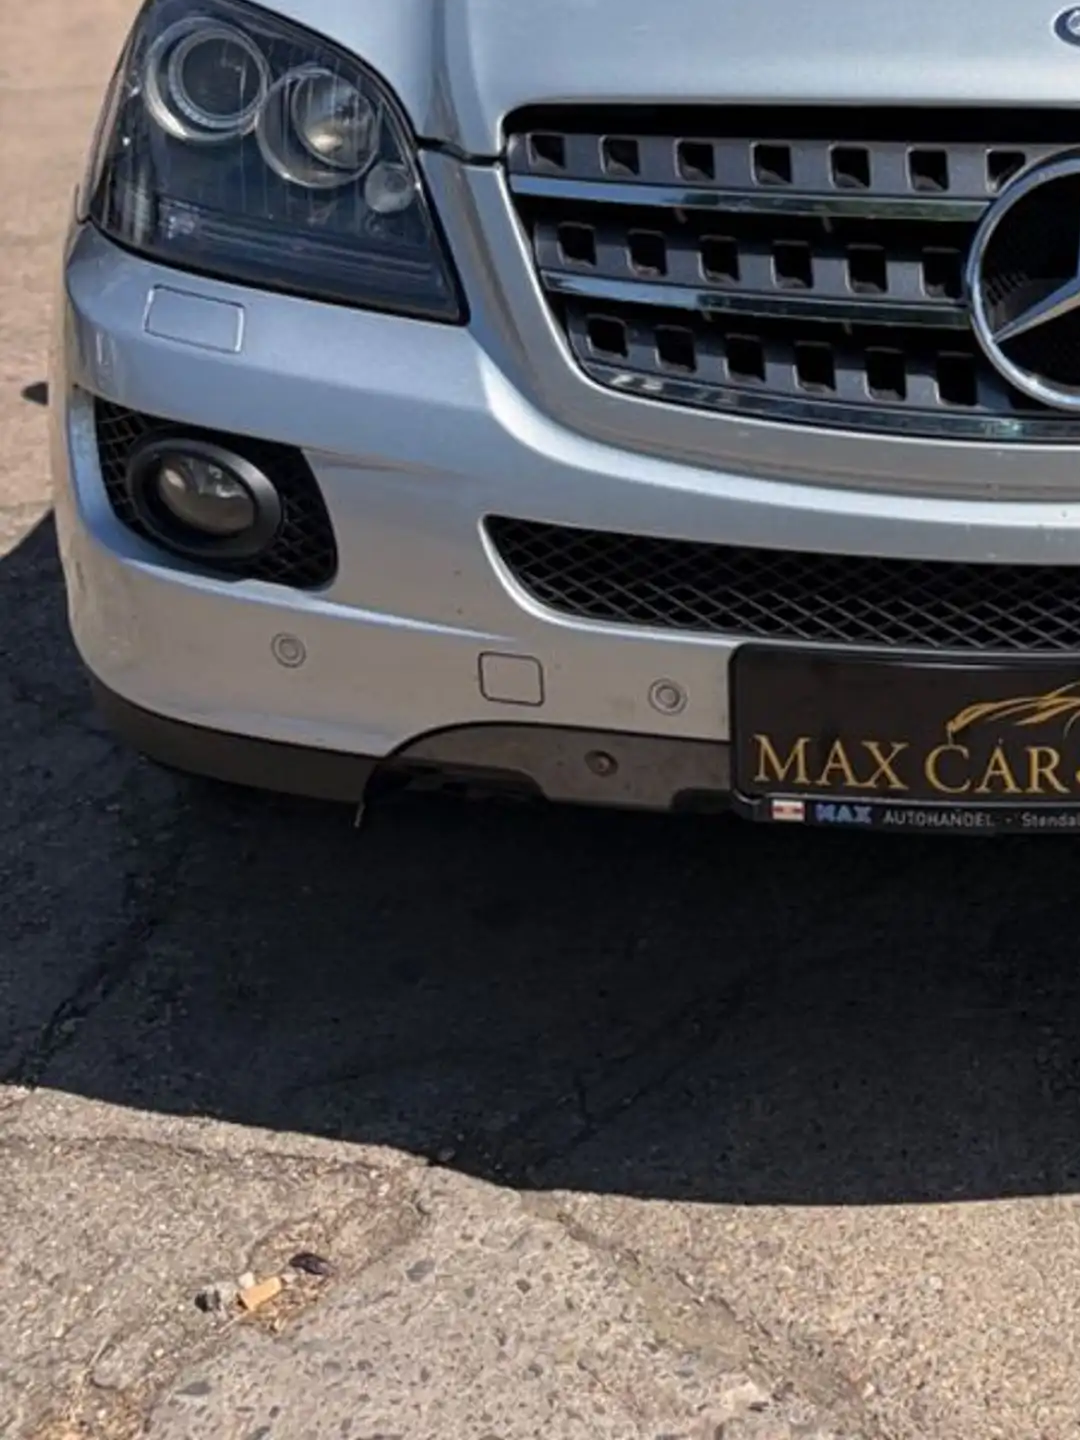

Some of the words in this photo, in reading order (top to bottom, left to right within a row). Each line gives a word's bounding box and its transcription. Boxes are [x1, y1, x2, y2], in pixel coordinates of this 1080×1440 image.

[753, 734, 909, 790] MAX
[815, 803, 872, 824] MAX
[883, 809, 995, 827] AUTOHANDEL
